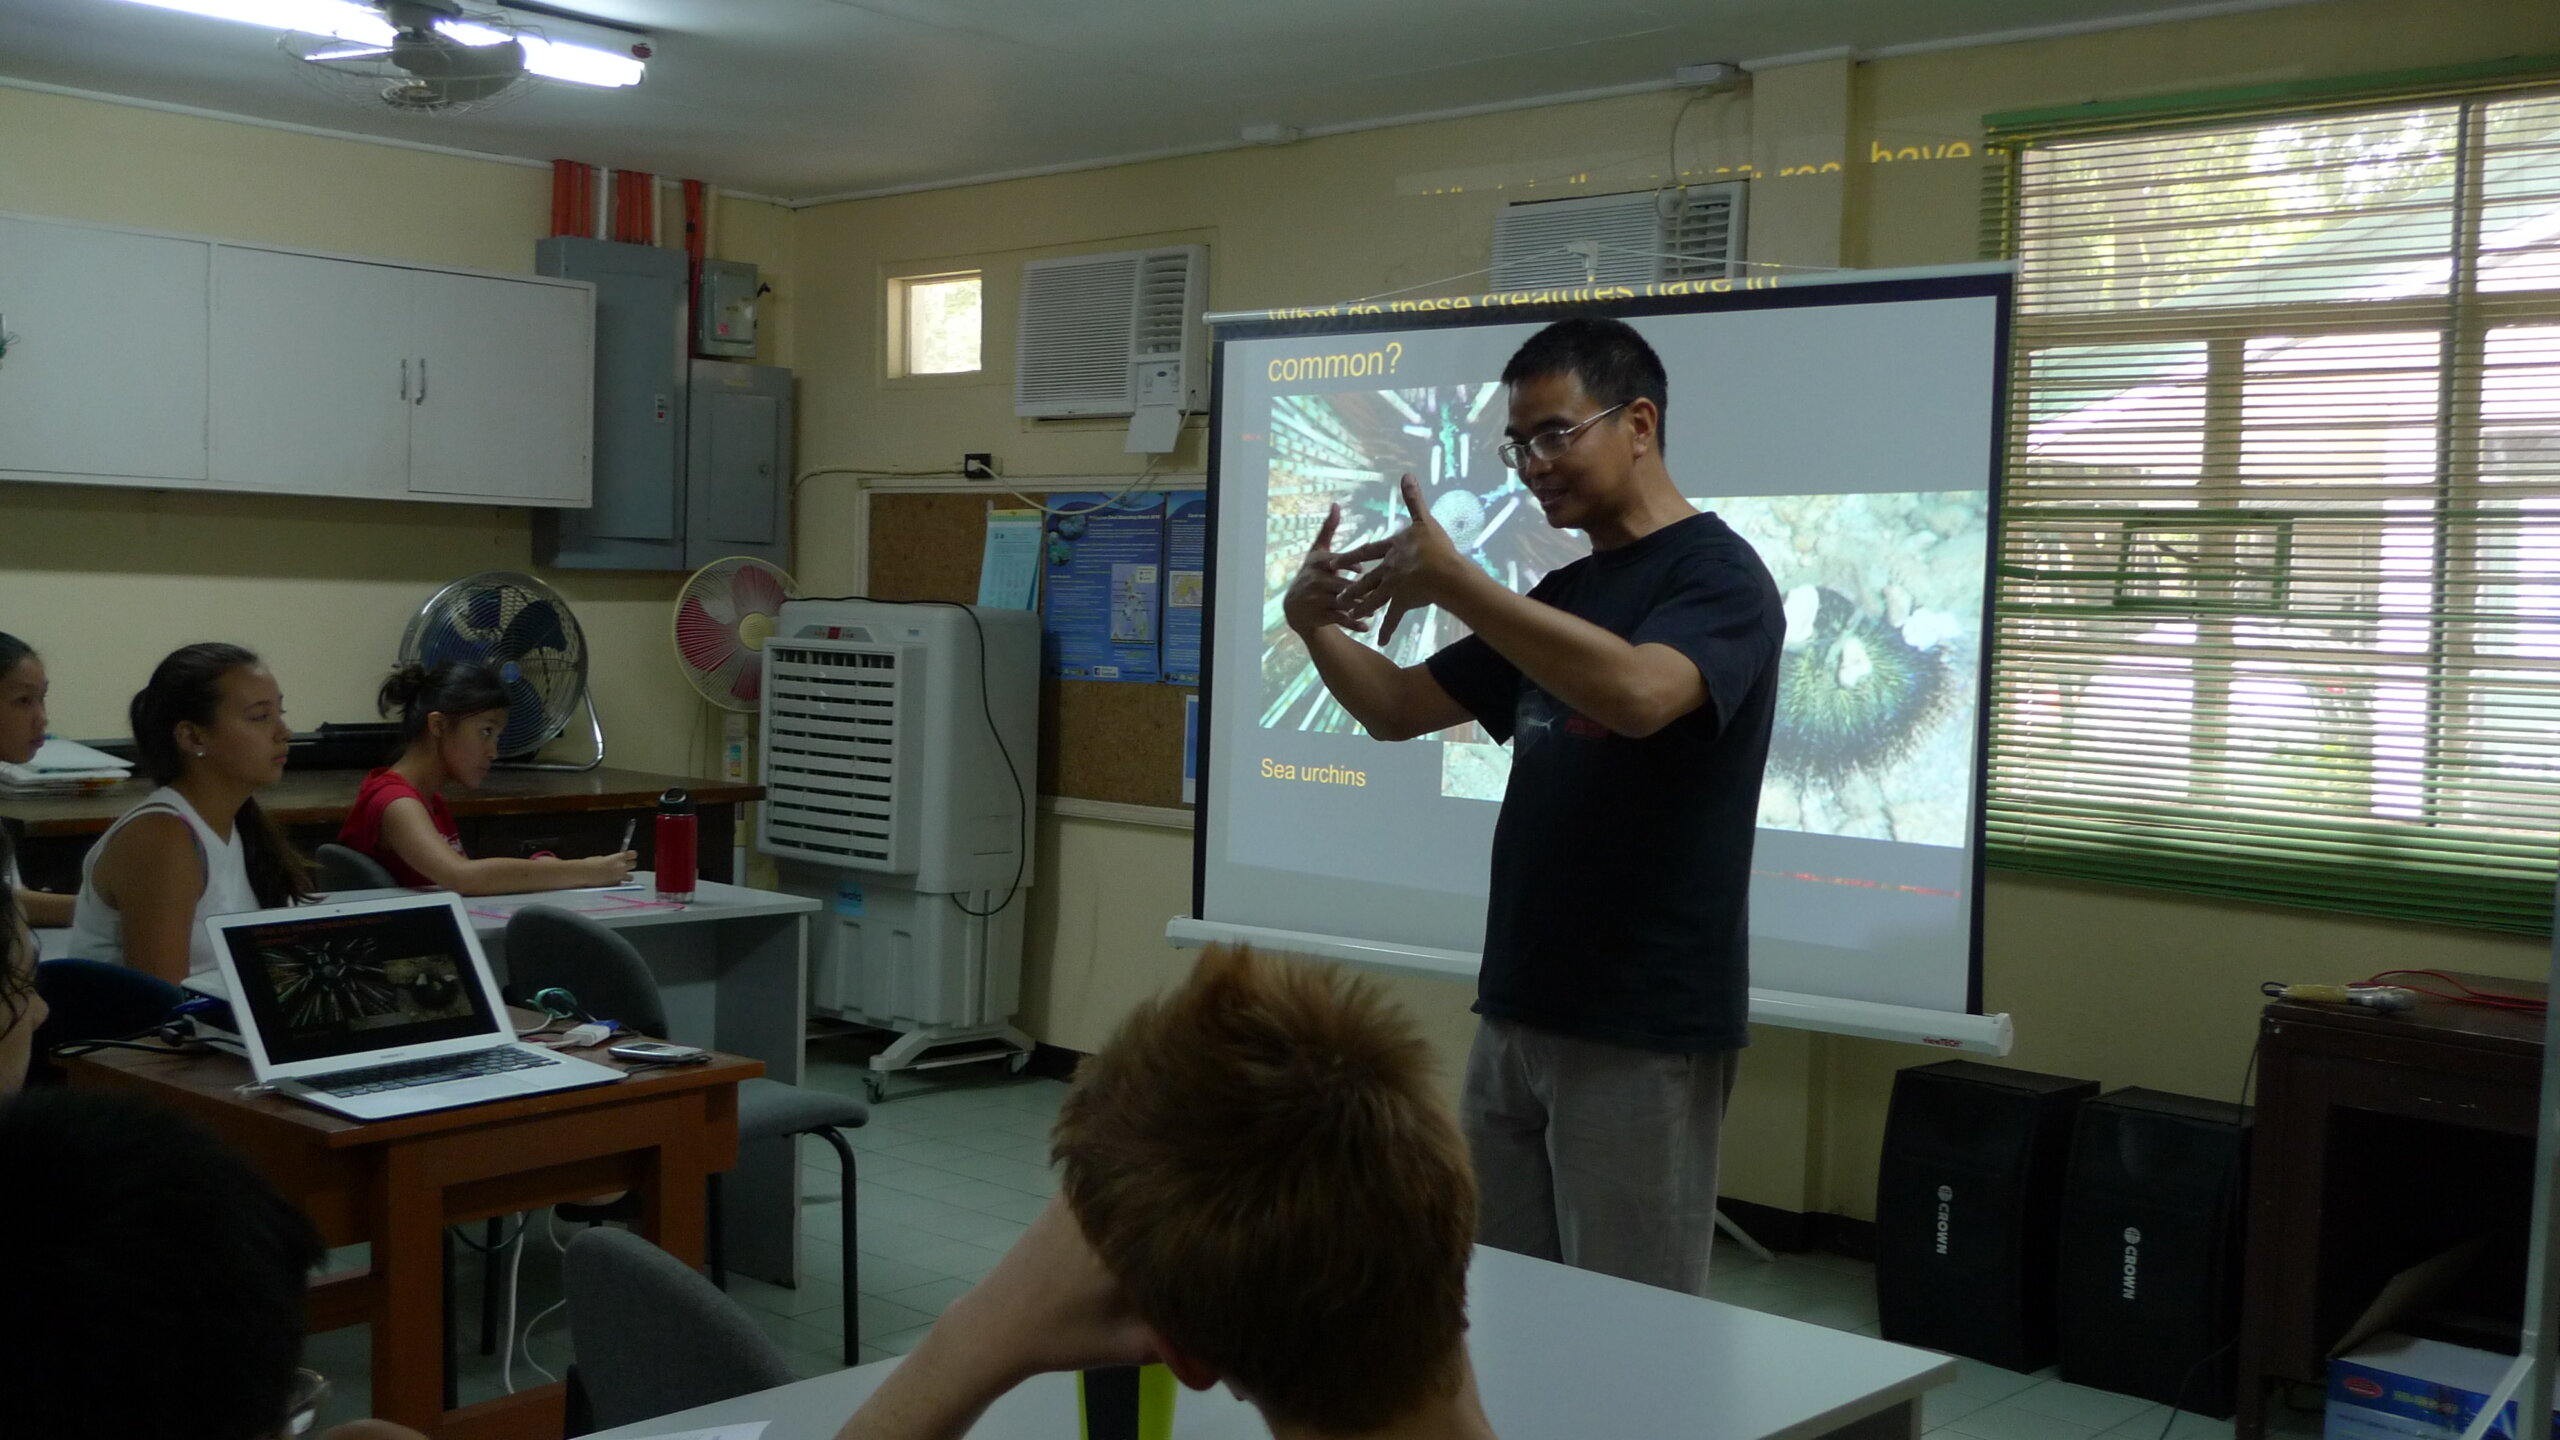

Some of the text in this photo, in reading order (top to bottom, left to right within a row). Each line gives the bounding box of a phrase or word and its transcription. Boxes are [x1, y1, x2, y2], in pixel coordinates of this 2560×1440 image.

[1268, 341, 1403, 382] common?
[1260, 757, 1367, 788] Sea urchins
[1935, 1202, 1951, 1255] CROWN
[2121, 1244, 2139, 1300] CROWN
